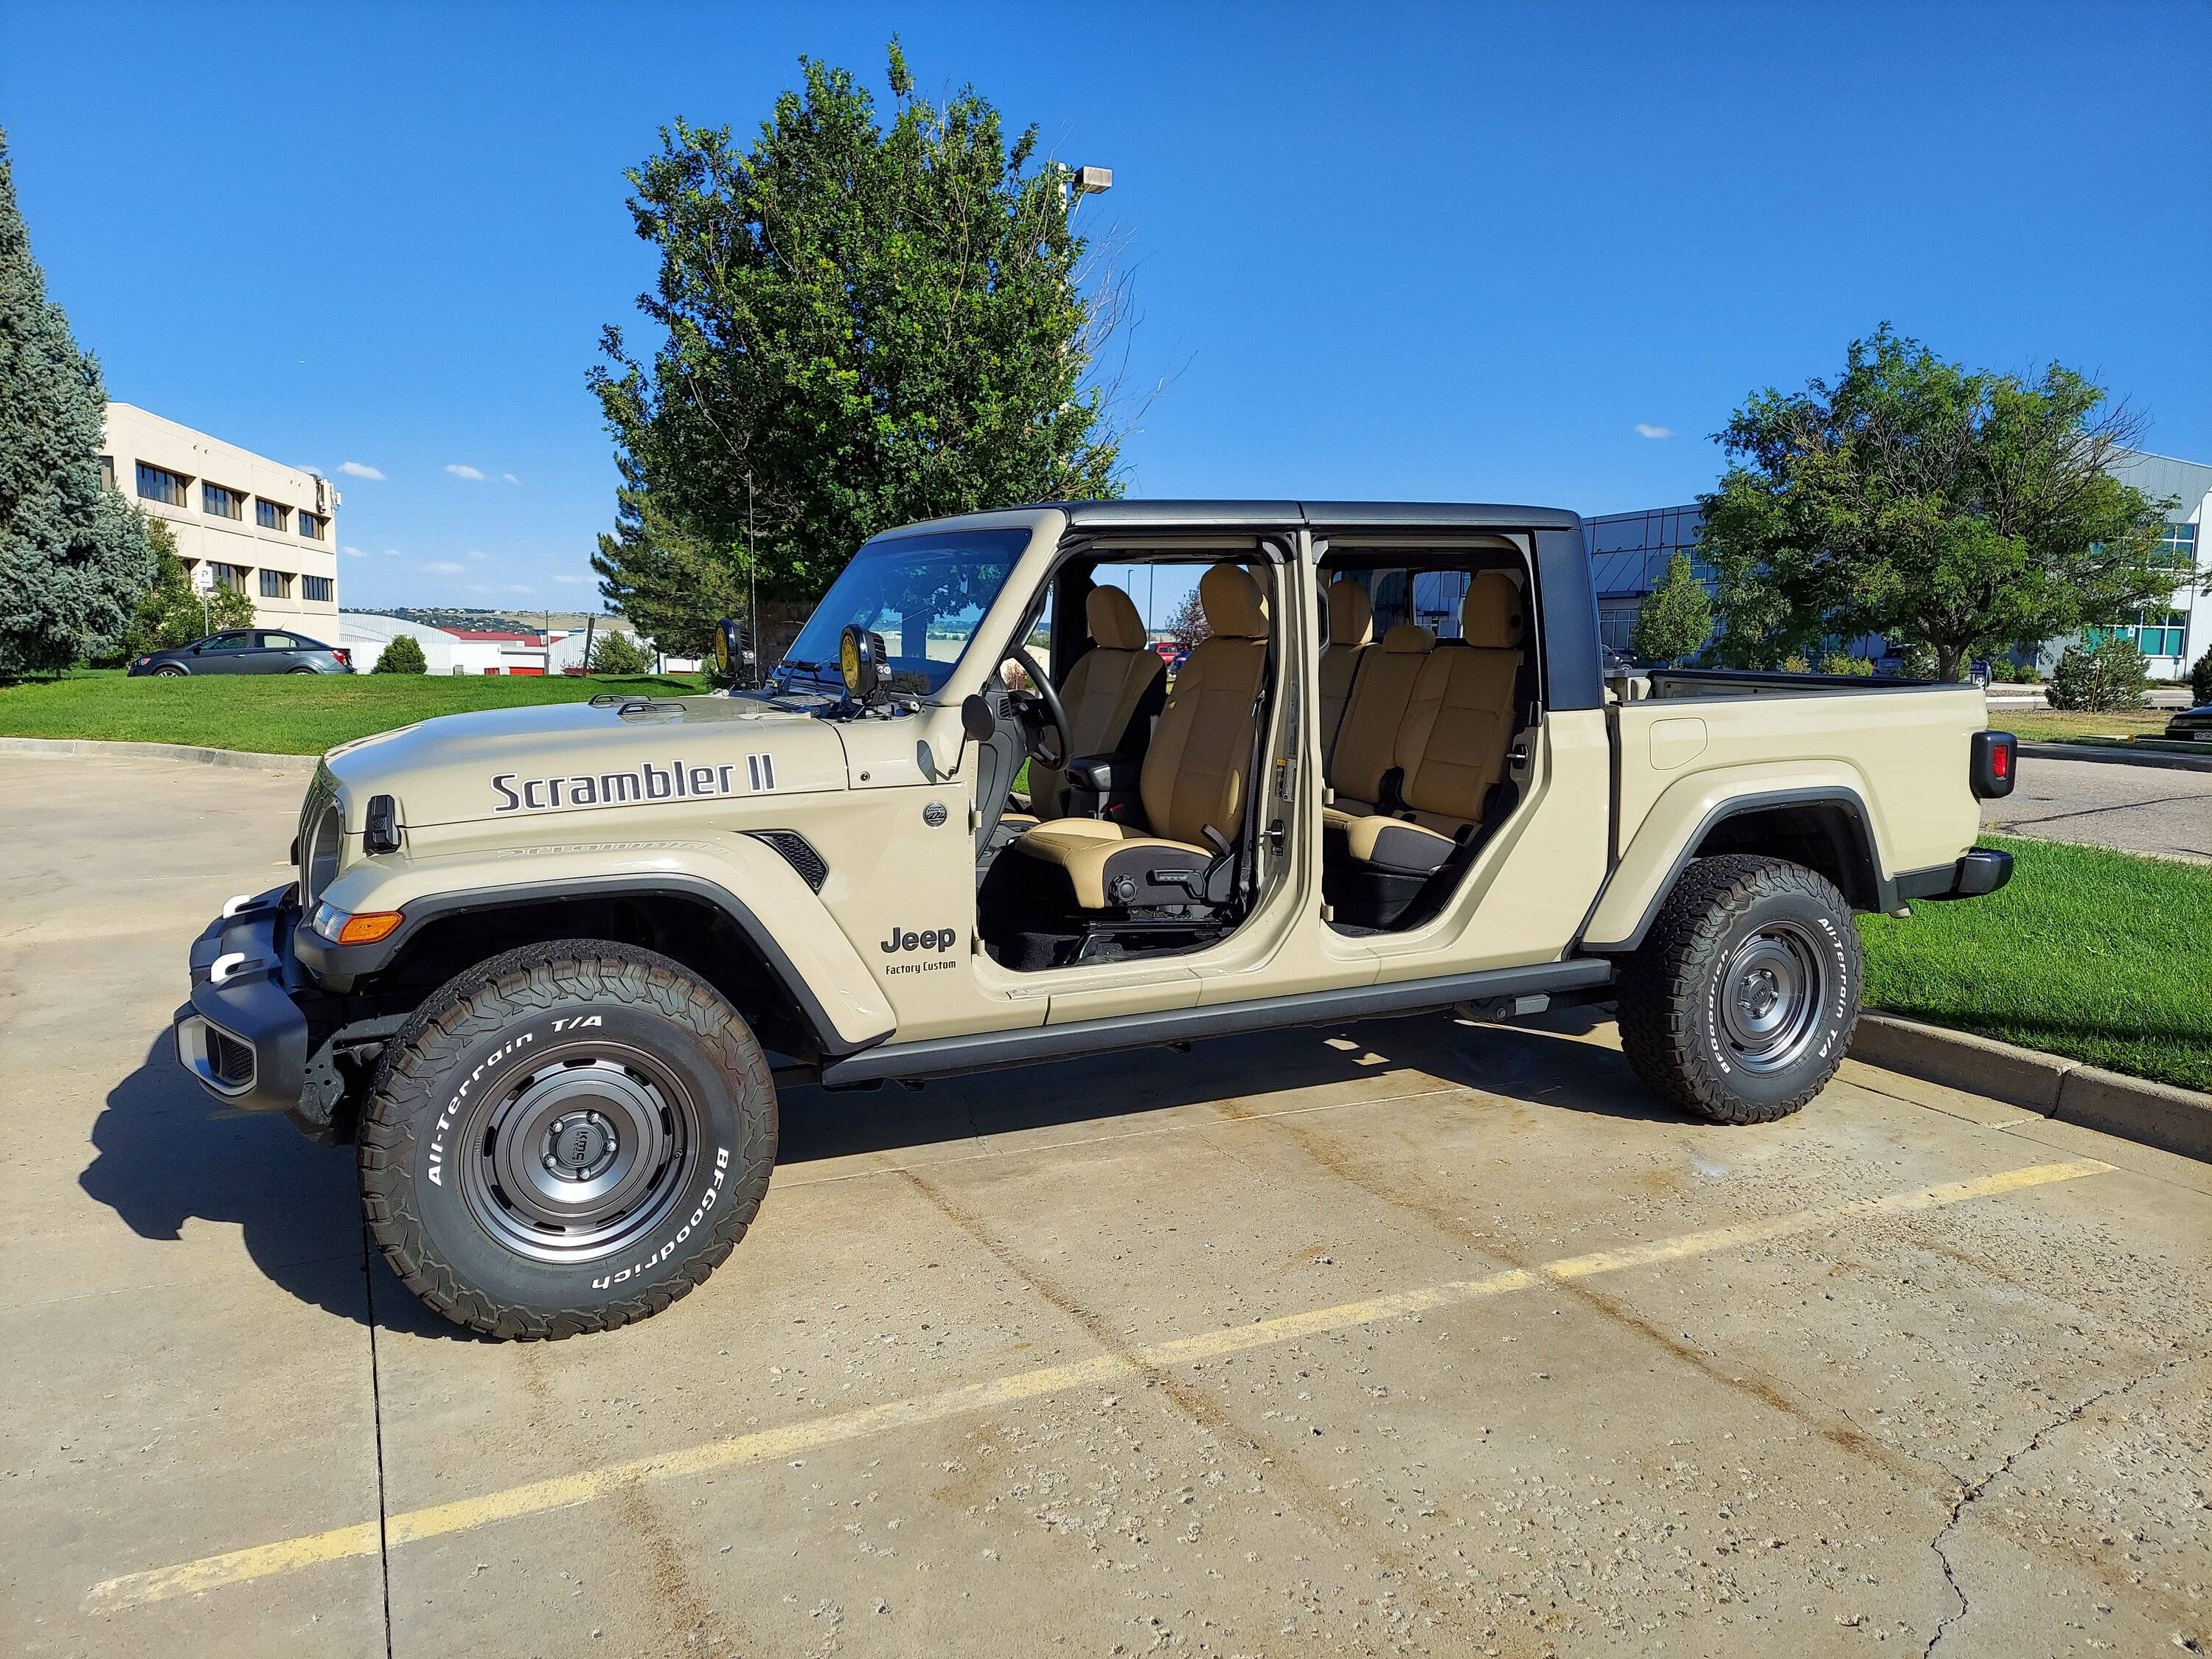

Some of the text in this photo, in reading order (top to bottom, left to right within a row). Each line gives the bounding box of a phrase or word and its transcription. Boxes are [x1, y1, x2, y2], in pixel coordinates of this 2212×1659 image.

[491, 752, 776, 813] Scrambler II
[881, 927, 956, 953] Jeep
[886, 961, 956, 975] Factory Custom
[1817, 917, 1848, 1059] All-Terrain T/A
[1708, 949, 1729, 1074] BFGoodrich
[428, 1015, 602, 1187] All-Terrain T/A
[591, 1147, 730, 1290] BFGoodrich
